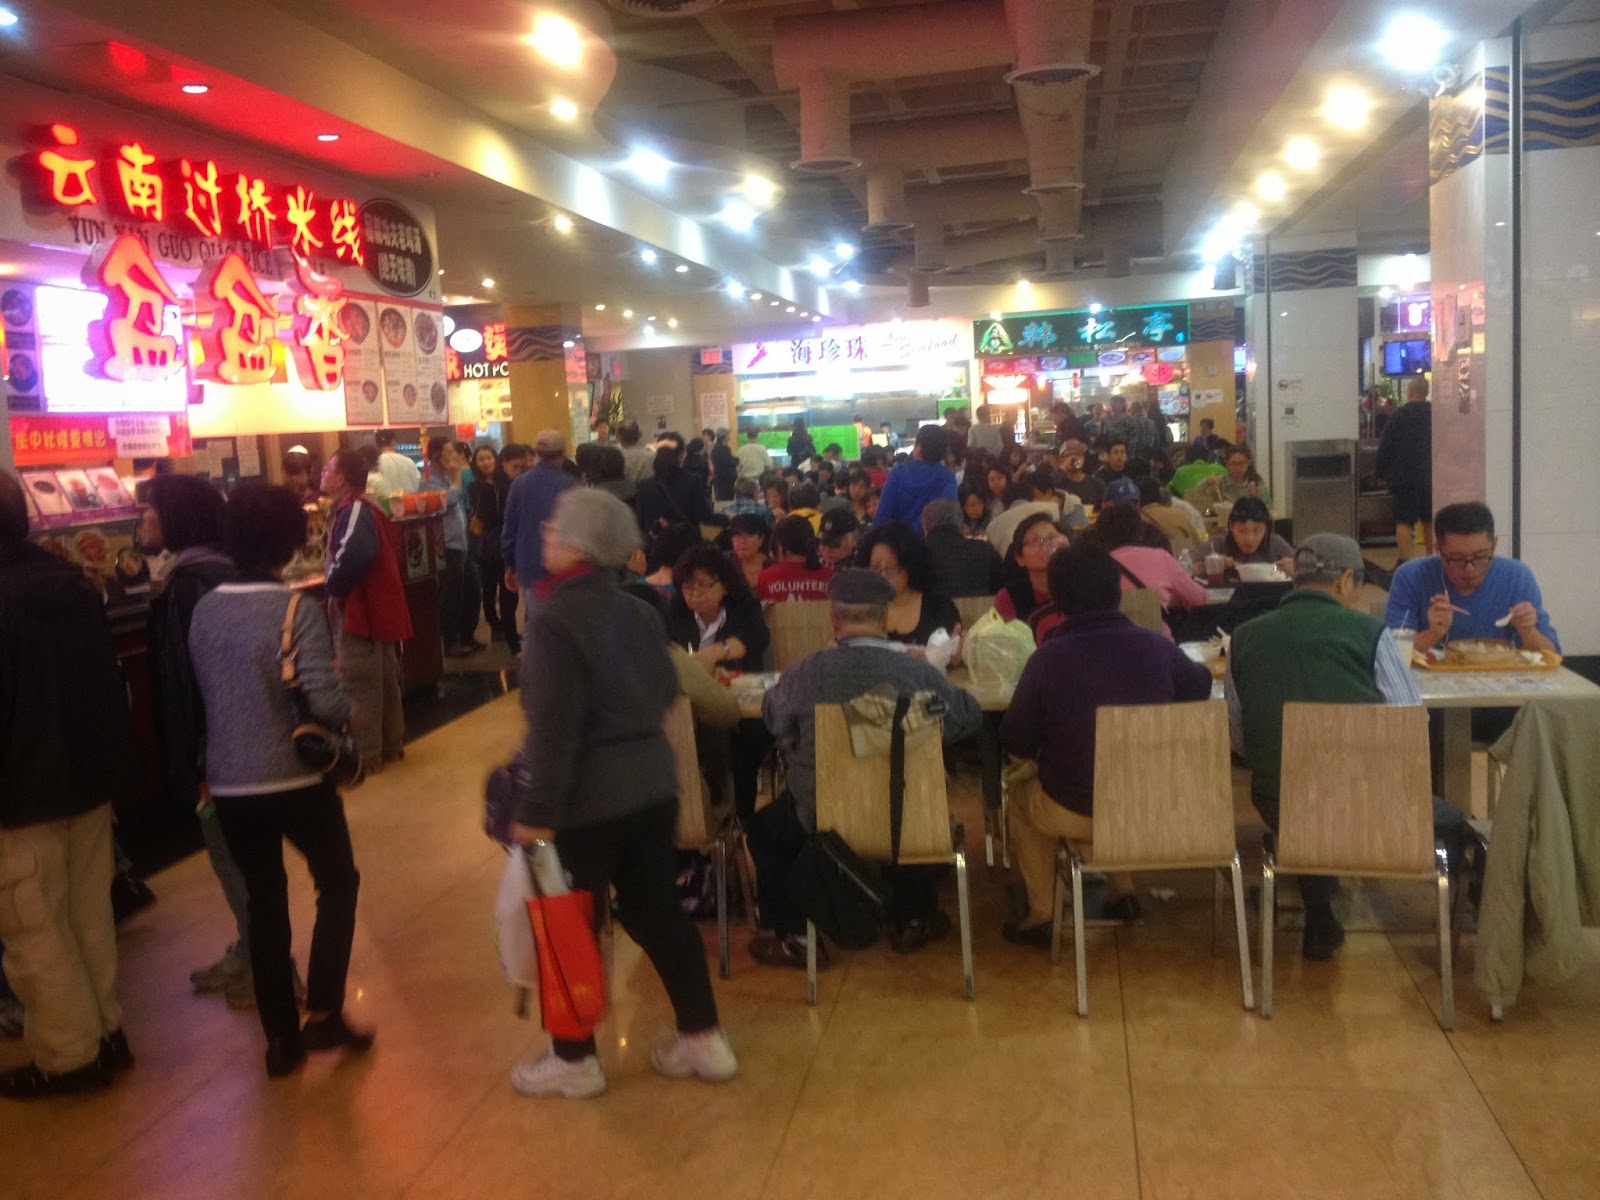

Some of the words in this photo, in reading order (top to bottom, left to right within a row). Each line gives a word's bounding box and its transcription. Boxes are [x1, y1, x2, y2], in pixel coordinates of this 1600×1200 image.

[39, 123, 364, 267] 云南过桥米线
[68, 216, 105, 245] YUN
[158, 232, 192, 262] GUO
[790, 335, 868, 365] 海珍珠
[463, 362, 489, 378] HOT
[492, 361, 509, 377] PO
